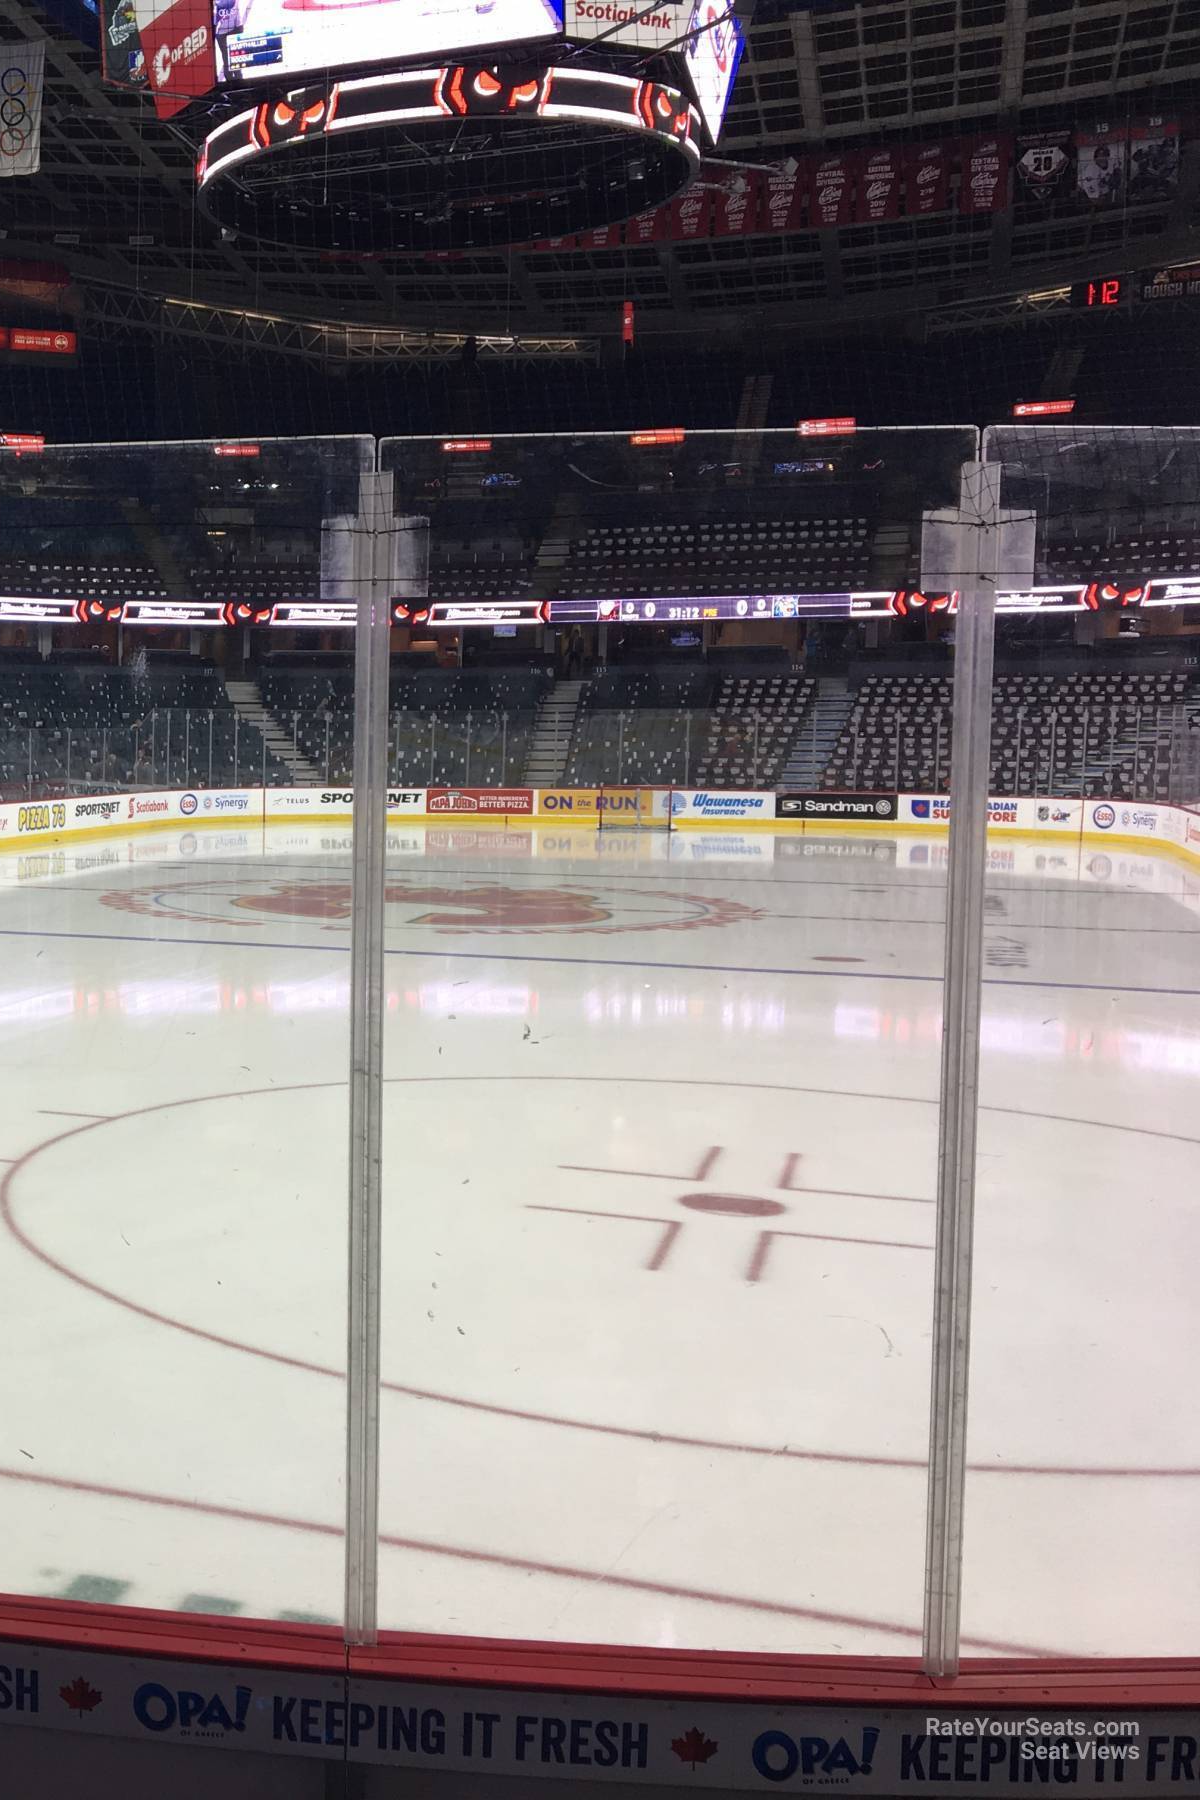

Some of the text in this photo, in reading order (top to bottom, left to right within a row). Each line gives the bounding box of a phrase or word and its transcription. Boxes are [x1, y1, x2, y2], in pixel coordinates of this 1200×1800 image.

[183, 25, 208, 59] RED
[1143, 282, 1183, 299] ROUGH
[644, 602, 656, 618] 0
[669, 607, 699, 618] 31:12
[736, 599, 748, 615] 0
[215, 796, 249, 810] Synergy
[320, 792, 422, 804] SPONET
[431, 797, 451, 809] PAPA
[543, 795, 573, 810] ON
[577, 798, 592, 807] the
[692, 793, 764, 808] Wawanesa
[75, 801, 120, 817] SPORTSNET
[136, 799, 169, 813] Scotiabank
[701, 807, 746, 816] Insurance
[804, 800, 874, 812] Sandman
[18, 803, 66, 831] PIZZA 73
[932, 811, 1017, 823] SUTORE
[1132, 813, 1157, 831] Synergy
[133, 1681, 649, 1769] OPA! KEEPING IT FRESH
[752, 1726, 1200, 1784] OPA! KEEPING IT FR
